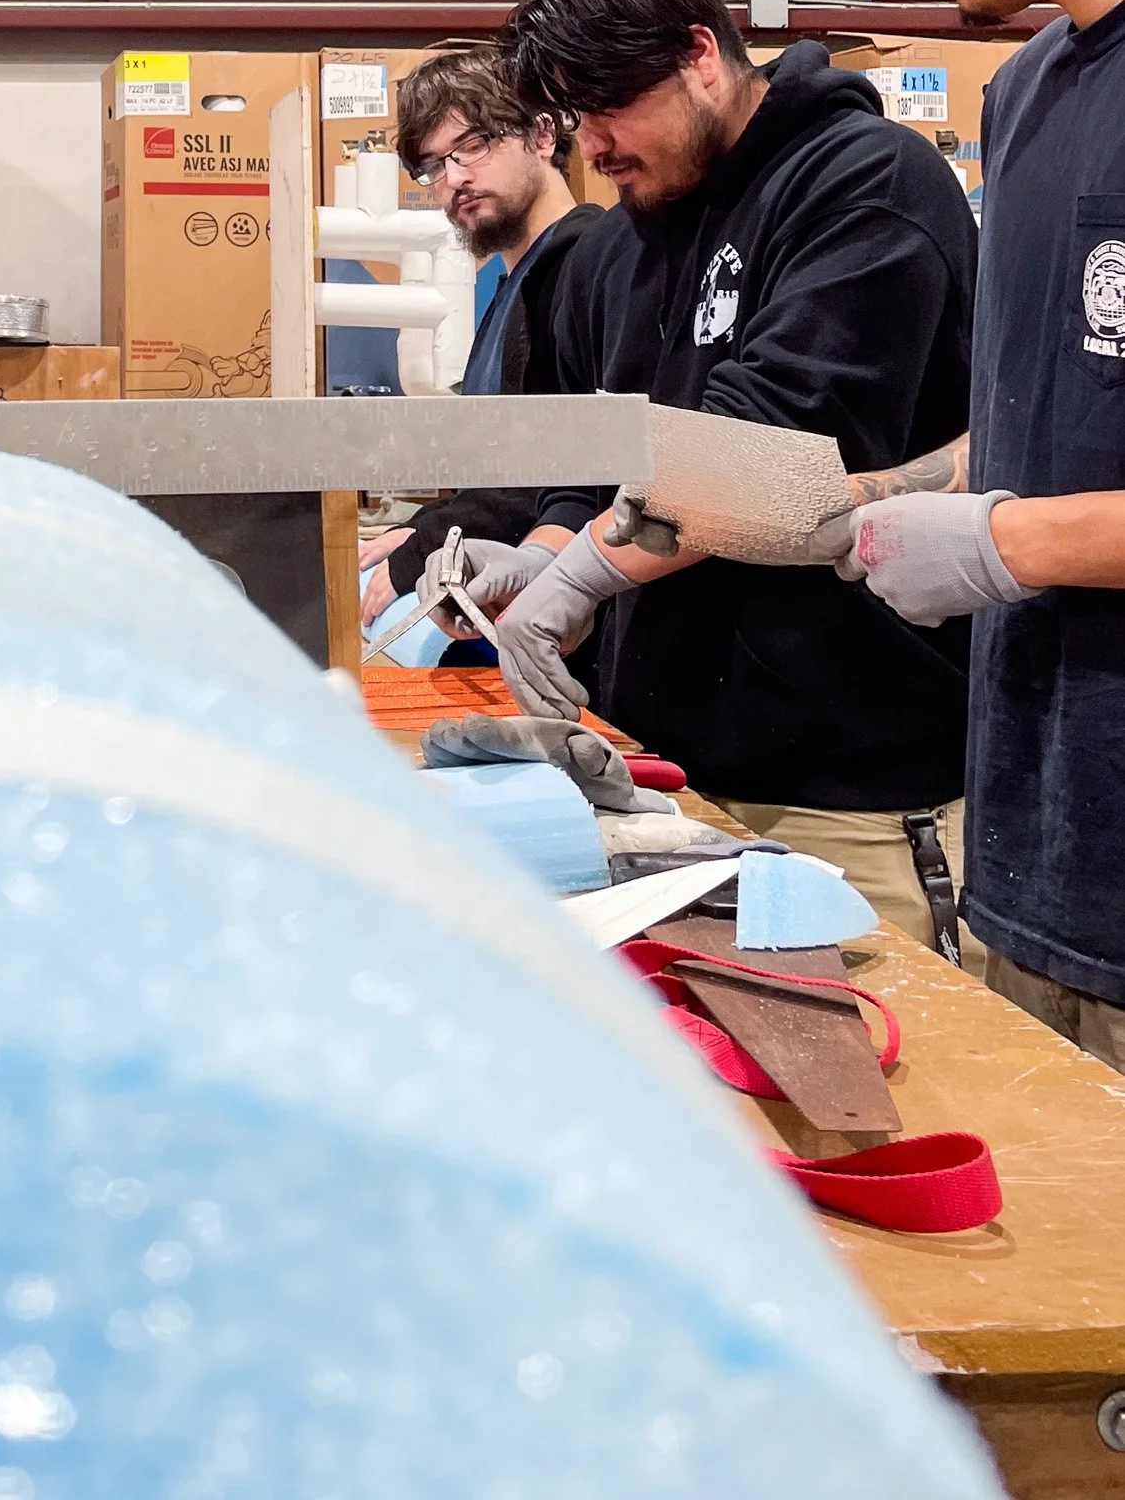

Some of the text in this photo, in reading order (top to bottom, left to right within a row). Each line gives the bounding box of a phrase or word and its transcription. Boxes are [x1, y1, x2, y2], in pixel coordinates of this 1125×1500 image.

[125, 60, 130, 69] 3
[142, 60, 146, 69] 1
[128, 85, 153, 93] 722577
[902, 72, 908, 90] 4
[183, 134, 214, 153] SSL
[183, 156, 216, 171] AVEC
[220, 157, 242, 172] ASJ
[1083, 335, 1119, 357] LOCAL
